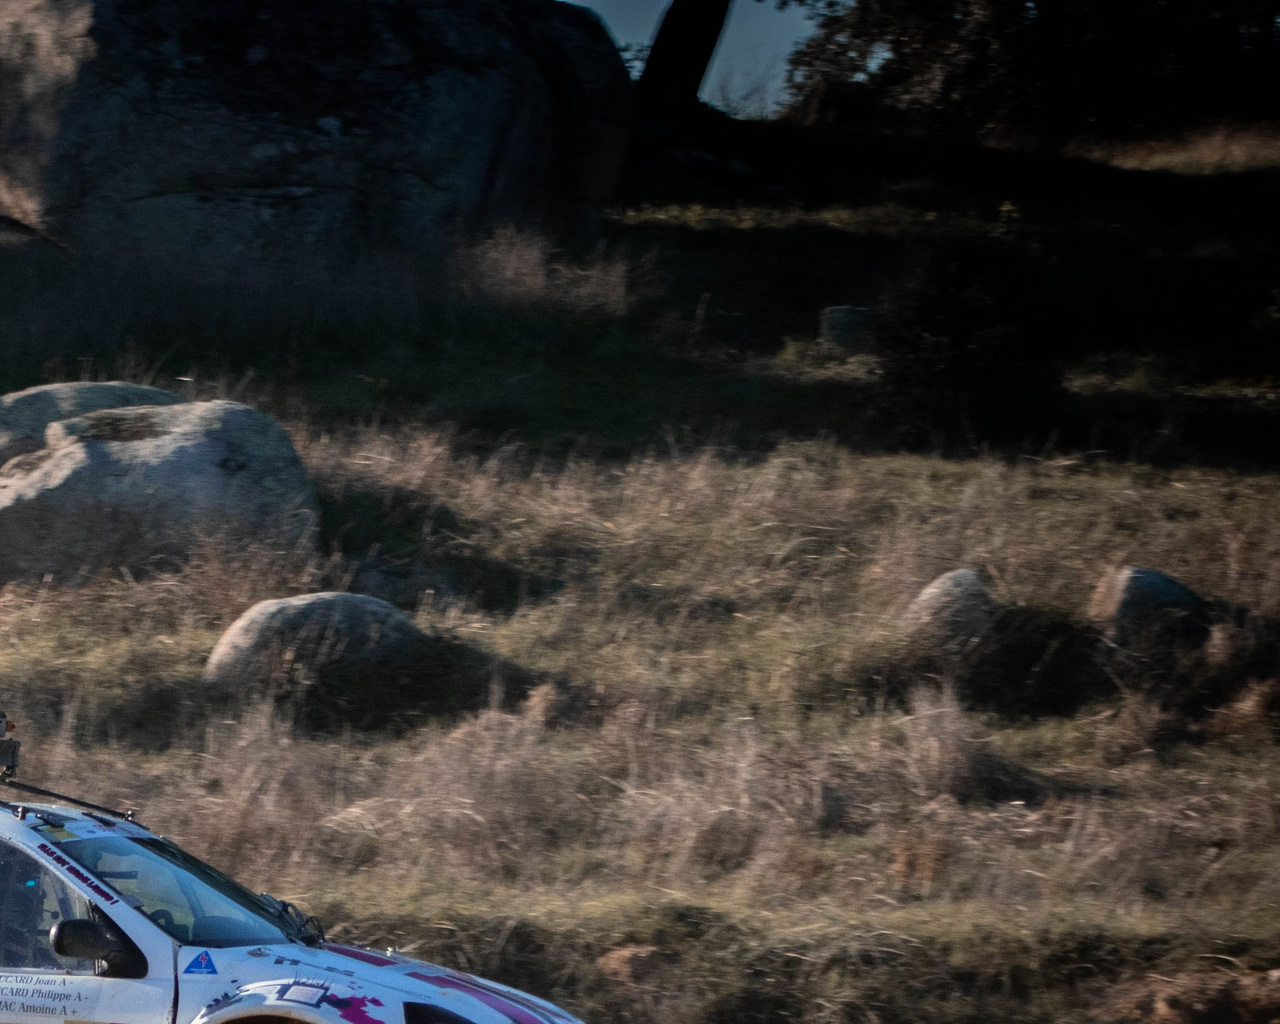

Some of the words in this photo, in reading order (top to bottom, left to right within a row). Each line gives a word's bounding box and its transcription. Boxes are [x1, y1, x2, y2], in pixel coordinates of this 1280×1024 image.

[34, 978, 56, 986] Jean
[58, 978, 66, 986] A
[30, 990, 72, 1002] Philippe
[74, 992, 81, 1001] A
[18, 1003, 56, 1014] Antoine
[60, 1006, 68, 1016] A
